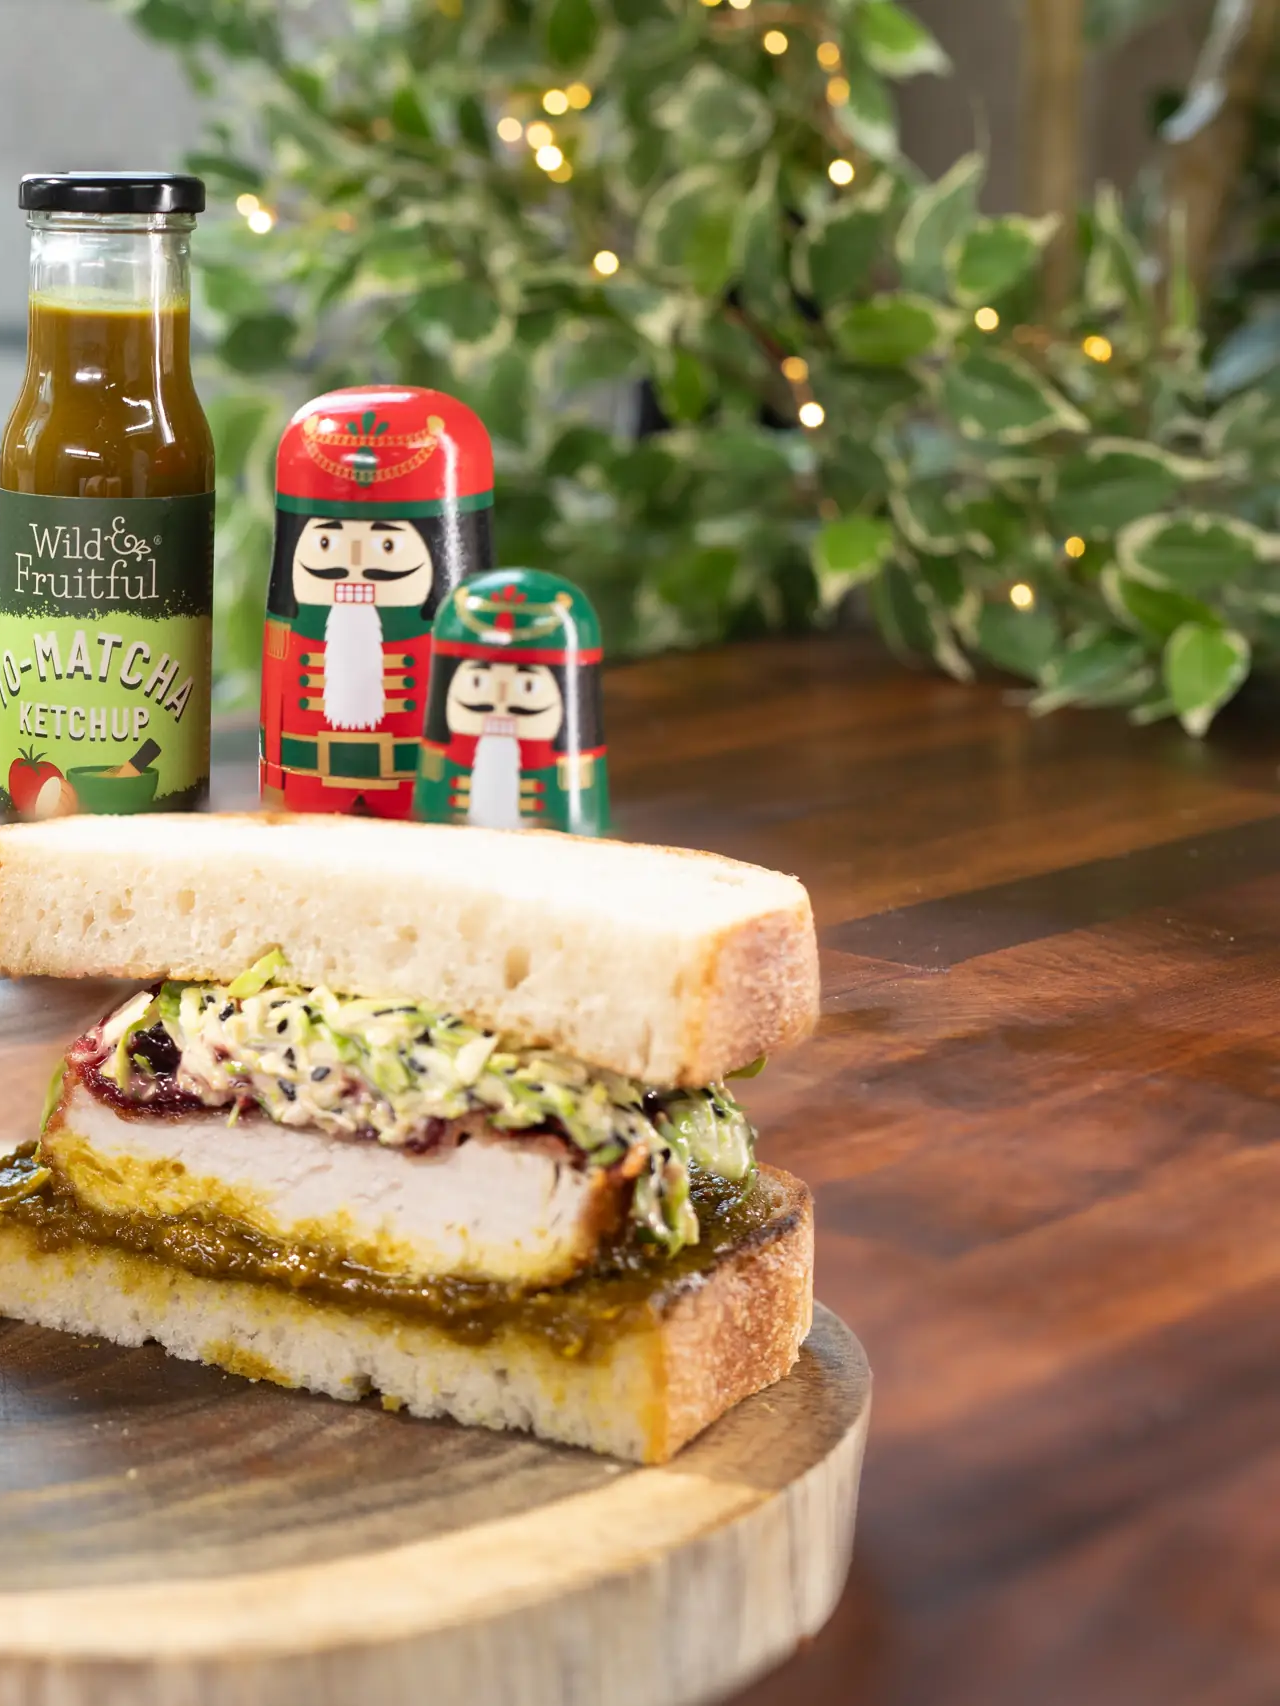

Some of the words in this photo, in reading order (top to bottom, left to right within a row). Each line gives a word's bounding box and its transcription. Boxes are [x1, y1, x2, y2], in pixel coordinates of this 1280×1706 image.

[28, 522, 105, 561] Wild
[14, 552, 160, 600] Fruitful
[19, 699, 151, 742] KETCHUP
